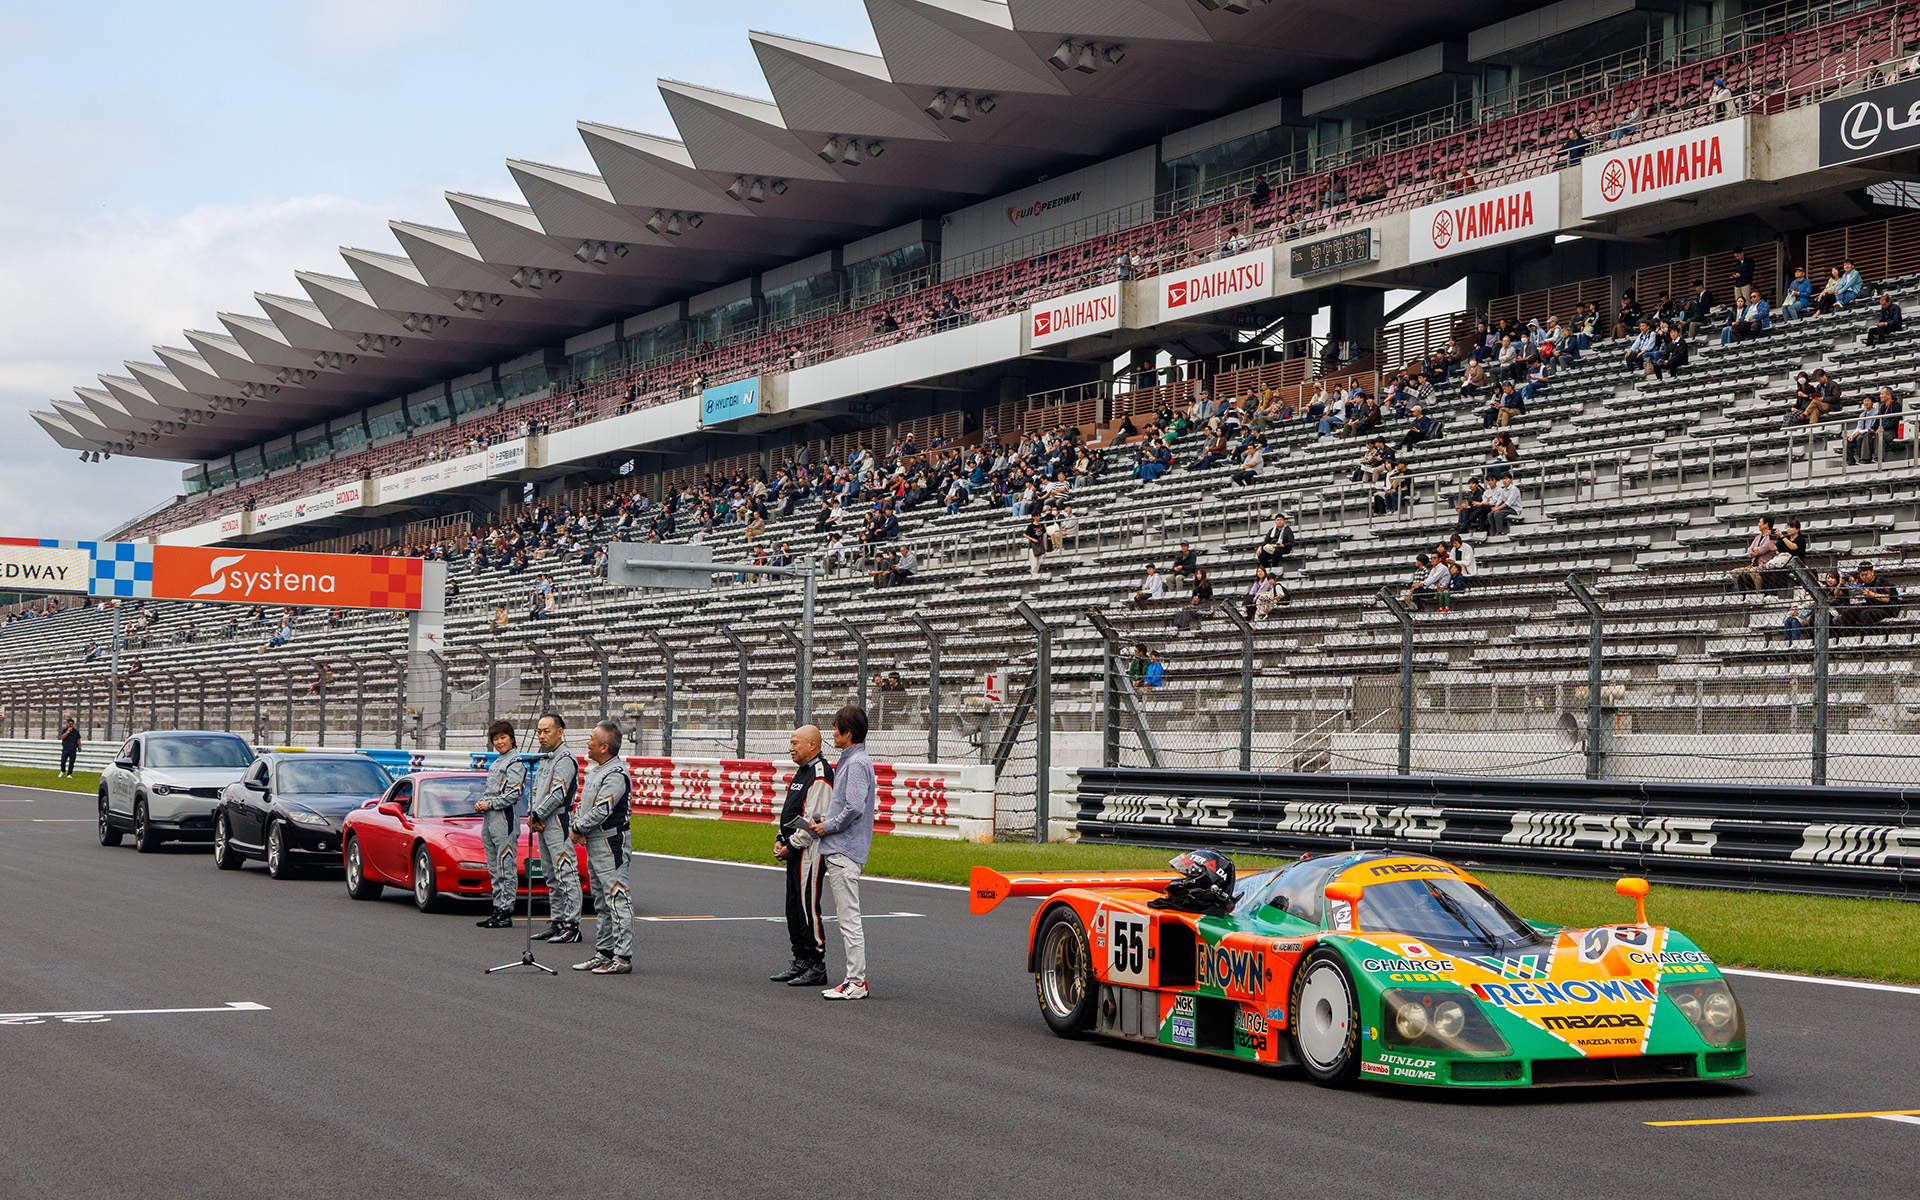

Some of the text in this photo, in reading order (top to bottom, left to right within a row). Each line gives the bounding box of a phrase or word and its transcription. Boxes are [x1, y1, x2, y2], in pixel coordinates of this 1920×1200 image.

[1628, 135, 1723, 195] YAMAHA
[1455, 190, 1534, 243] YAMAHA
[1312, 257, 1320, 269] 23
[1334, 250, 1342, 264] 30
[1190, 261, 1264, 303] DAIHATSU
[1054, 294, 1116, 332] DAIHATSU
[715, 390, 754, 410] HYUNDAI N
[463, 463, 483, 472] PORSCHE
[421, 473, 439, 482] PORSCHE
[336, 489, 359, 505] HONDA
[221, 519, 239, 532] HONDA
[230, 565, 335, 596] systena
[1370, 864, 1459, 877] mazda
[977, 890, 995, 898] mazda
[1114, 920, 1143, 975] 55
[1279, 942, 1303, 951] IDEMITSU
[1628, 951, 1713, 964] CHARGE
[1363, 958, 1456, 973] CHARGE
[1480, 977, 1659, 1007] RENOWN
[1175, 996, 1193, 1011] NGK
[1541, 1014, 1645, 1030] mazda
[1173, 1026, 1194, 1037] RAYS
[1379, 1053, 1436, 1068] DUNLOP
[1367, 1063, 1389, 1074] brembo
[1393, 1067, 1436, 1080] D40/M2
